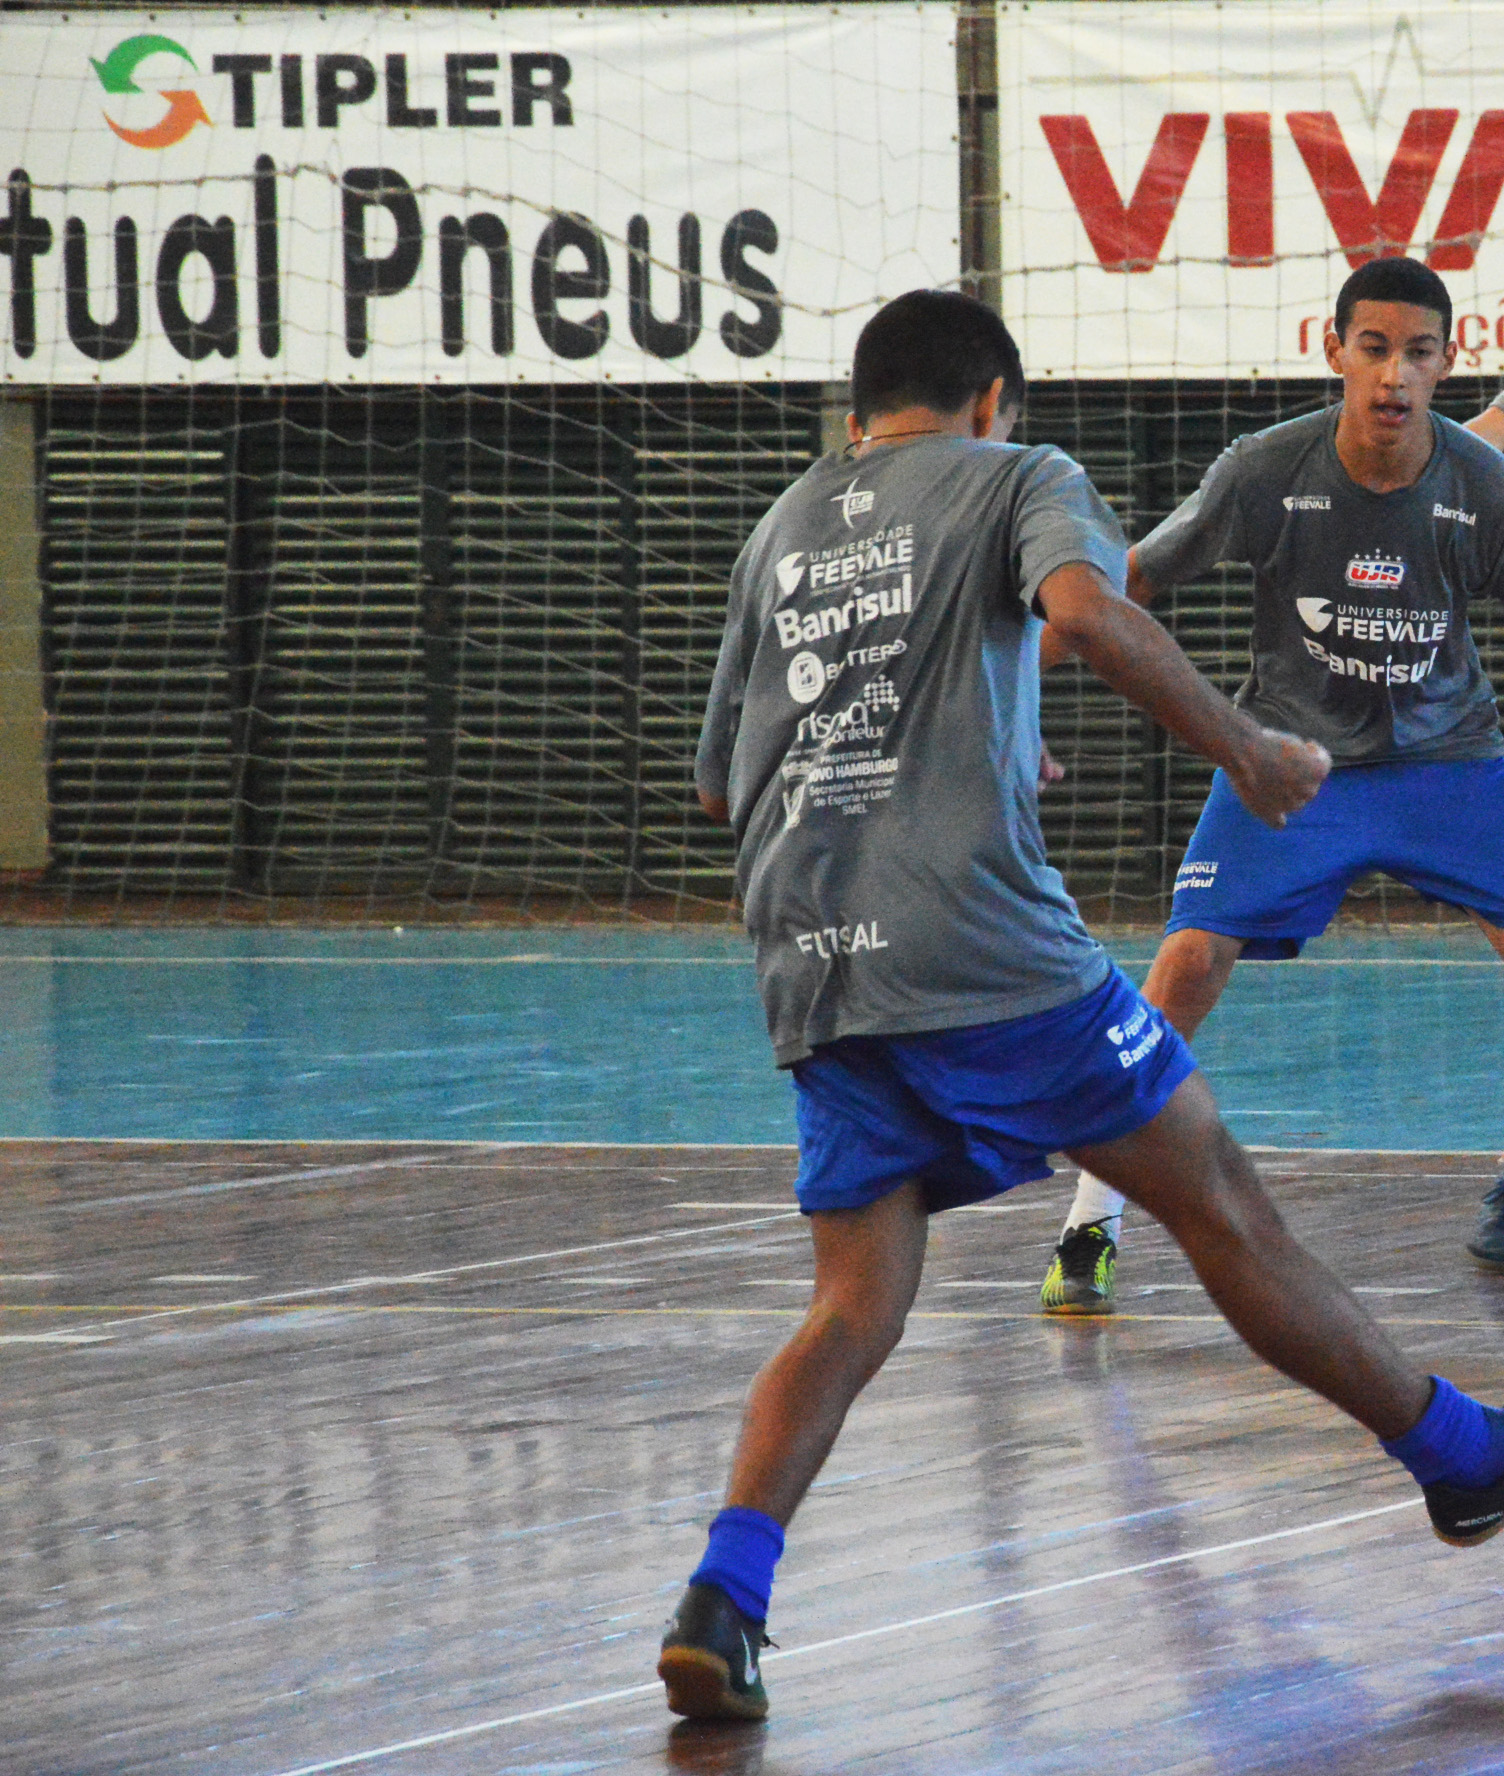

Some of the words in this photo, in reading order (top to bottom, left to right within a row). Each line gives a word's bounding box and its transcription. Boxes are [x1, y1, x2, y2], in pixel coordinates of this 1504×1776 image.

[213, 53, 575, 127] TIPLER
[342, 167, 782, 360] Pneus
[1294, 500, 1332, 510] FEEVALE
[1433, 503, 1476, 526] Banrisul
[810, 538, 914, 589] FEEVALE
[774, 573, 912, 649] Banrisul
[1337, 604, 1449, 621] UNIVERSIDADE
[1337, 617, 1448, 642] FEEVALE
[1303, 636, 1438, 687] Banrisul
[836, 757, 899, 778] HAMBURGO
